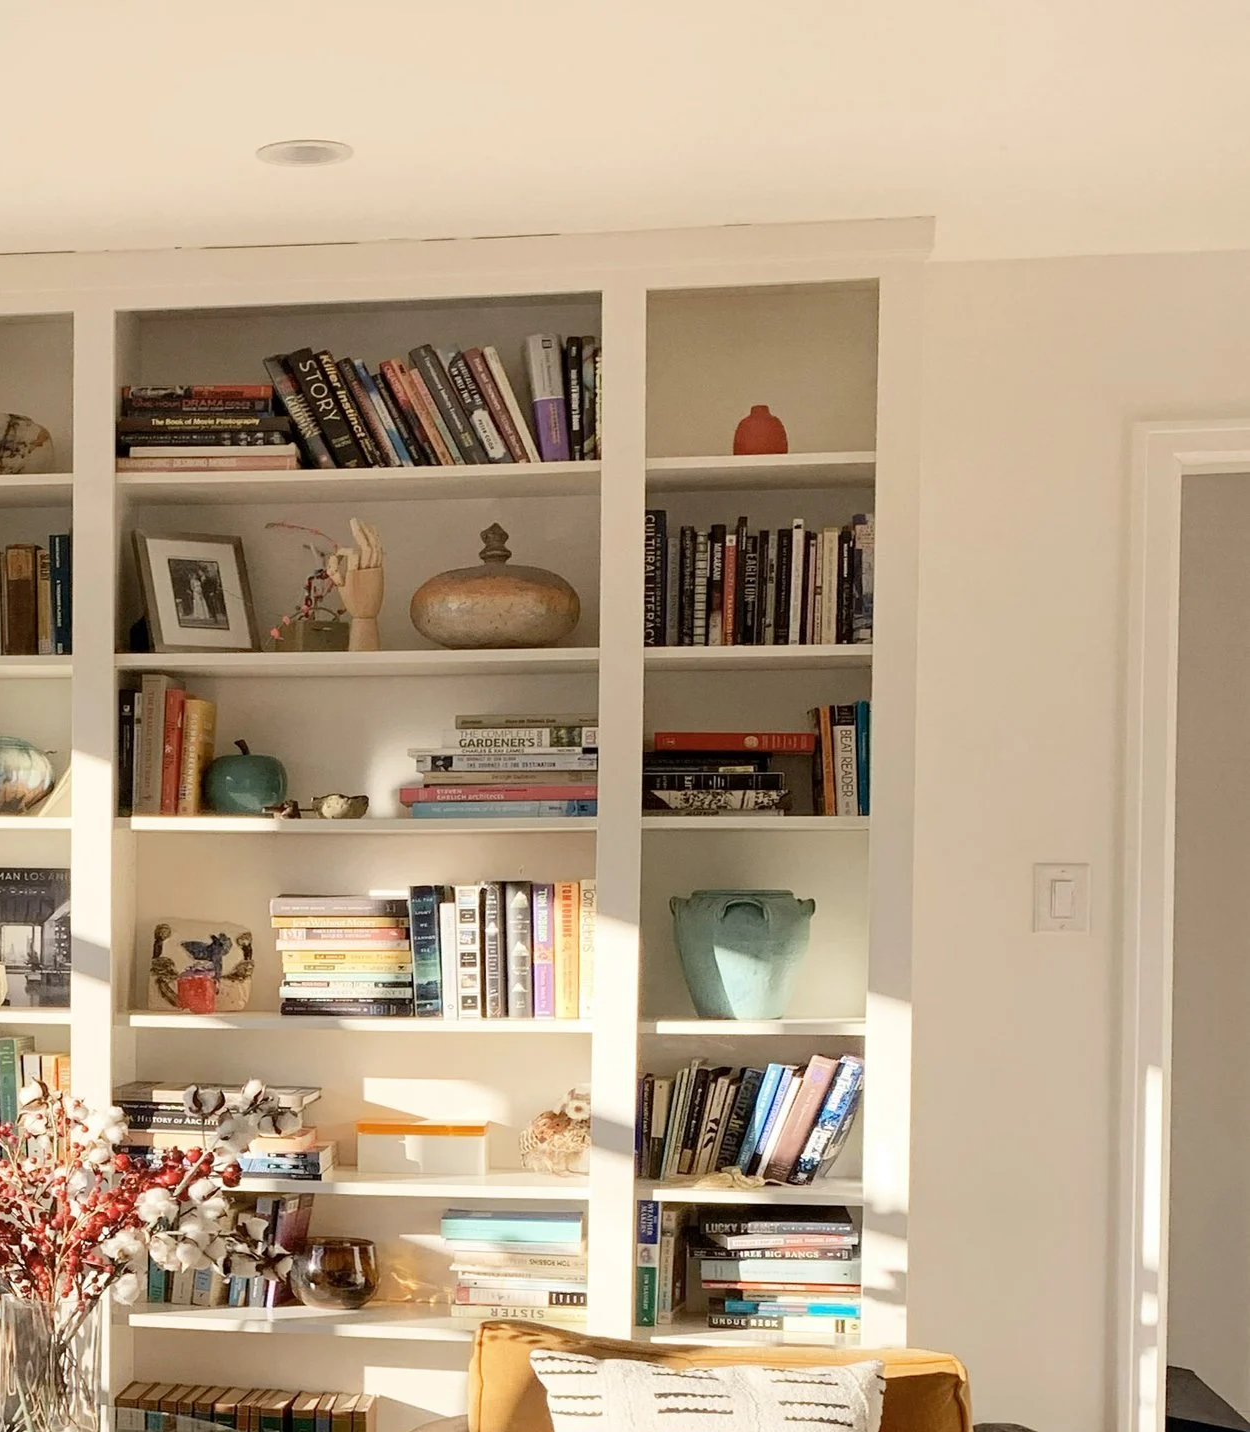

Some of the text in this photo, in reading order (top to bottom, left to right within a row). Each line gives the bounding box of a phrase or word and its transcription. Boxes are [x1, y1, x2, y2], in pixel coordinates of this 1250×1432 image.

[299, 359, 341, 421] STORY
[319, 354, 366, 438] Killer Instinct
[182, 399, 223, 407] DRAMA
[151, 418, 261, 427] The Book of Movie Photography
[712, 542, 722, 581] MURAKAMI
[644, 514, 656, 645] CULTURAL LITERACY
[744, 553, 758, 602] EAGLETON
[459, 730, 534, 739] THE COMPLETE
[459, 738, 536, 748] GARDENER'S
[185, 713, 198, 801] GLENN GREENWALD
[839, 729, 854, 798] BEAT READER
[467, 792, 504, 801] architects
[24, 872, 45, 882] LOS
[582, 886, 597, 909] Tom
[537, 888, 548, 942] TOM ROBBINS
[561, 884, 572, 938] TOM ROBBINS
[136, 1114, 172, 1124] HISTORY
[705, 1221, 779, 1233] LUCKY PLANET
[730, 1250, 763, 1259] THREE
[764, 1250, 782, 1259] BIG
[784, 1250, 820, 1259] BANGS
[490, 1307, 545, 1319] SISTER
[711, 1318, 779, 1328] UNDUE RISK
